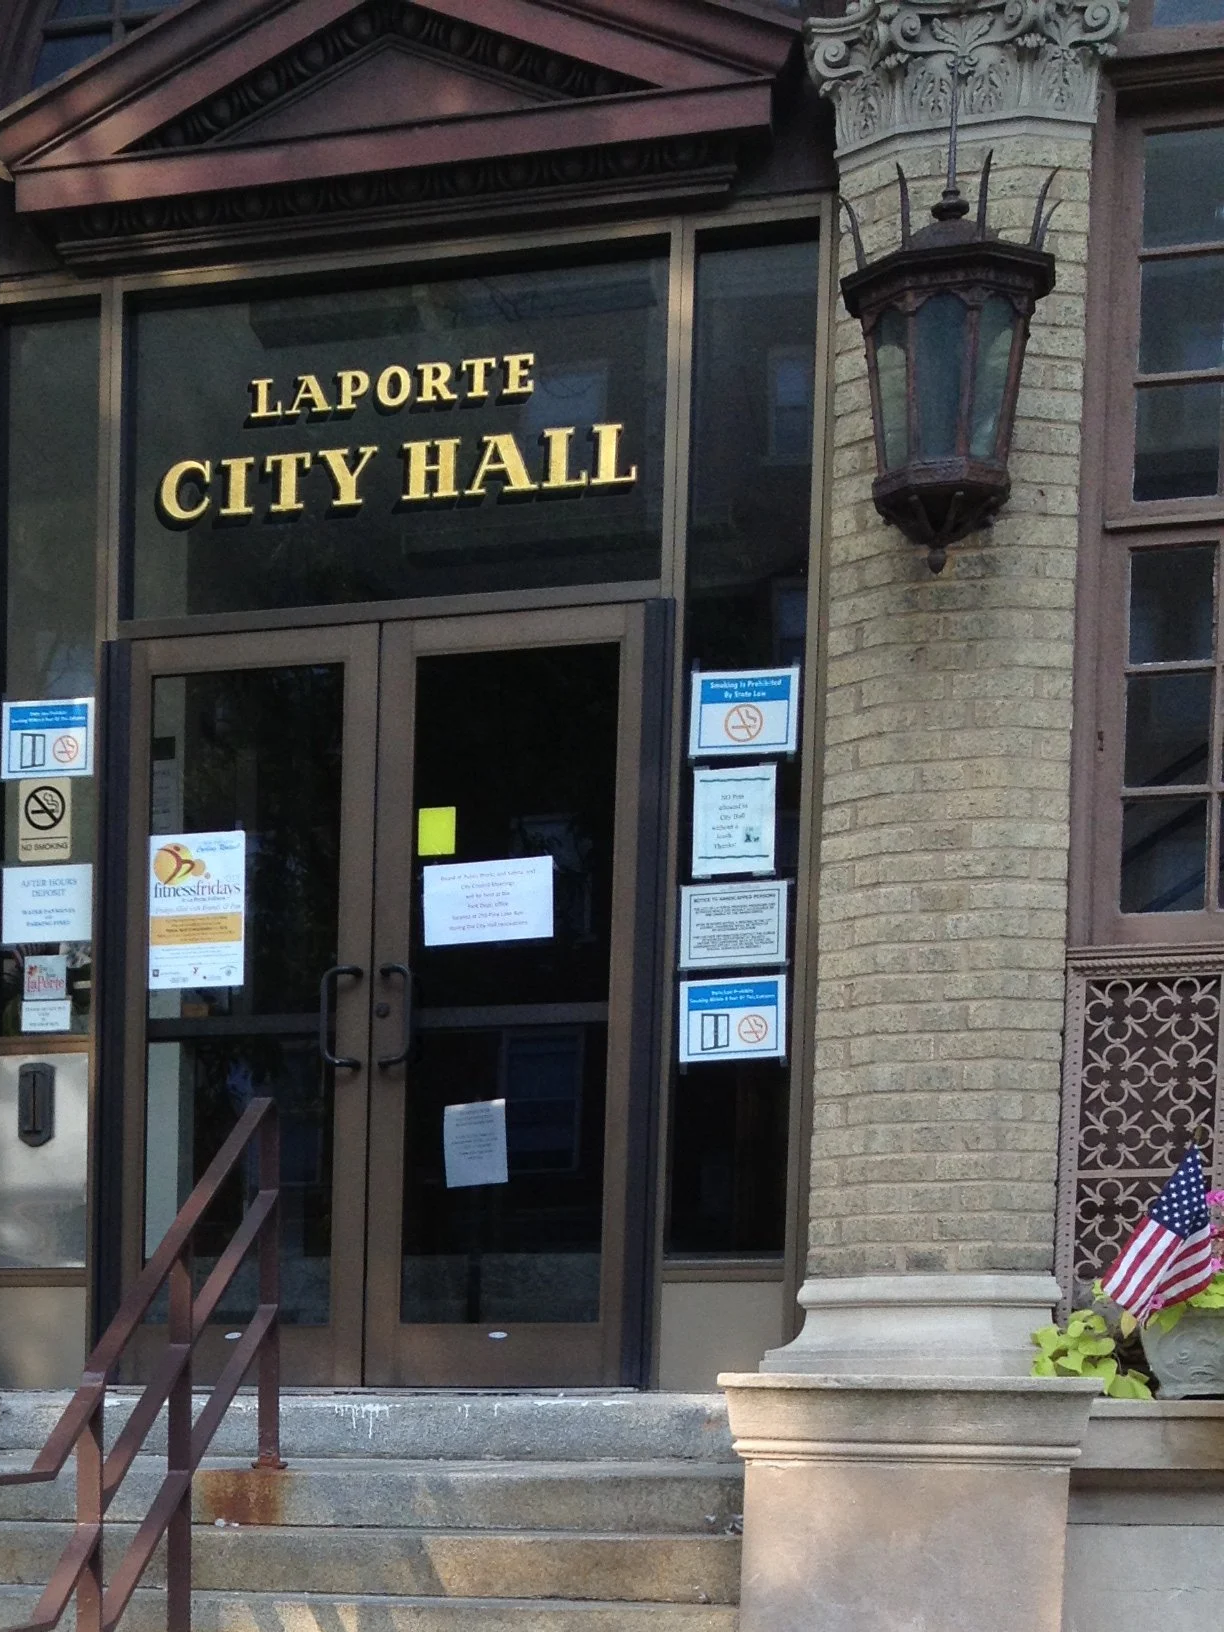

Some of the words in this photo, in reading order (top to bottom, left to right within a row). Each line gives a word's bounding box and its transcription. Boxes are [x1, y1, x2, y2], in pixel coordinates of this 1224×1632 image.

[250, 353, 534, 418] LAPORTE
[161, 445, 378, 521] CITY
[402, 423, 637, 501] HALL
[710, 681, 738, 689] Smoking
[747, 679, 782, 688] Prohibited
[723, 691, 732, 699] By
[34, 842, 68, 851] SMOKING
[20, 879, 47, 887] AFTER
[49, 878, 78, 886] HOURS
[154, 879, 241, 898] fitnessfridays
[32, 889, 66, 898] DEPOSIT
